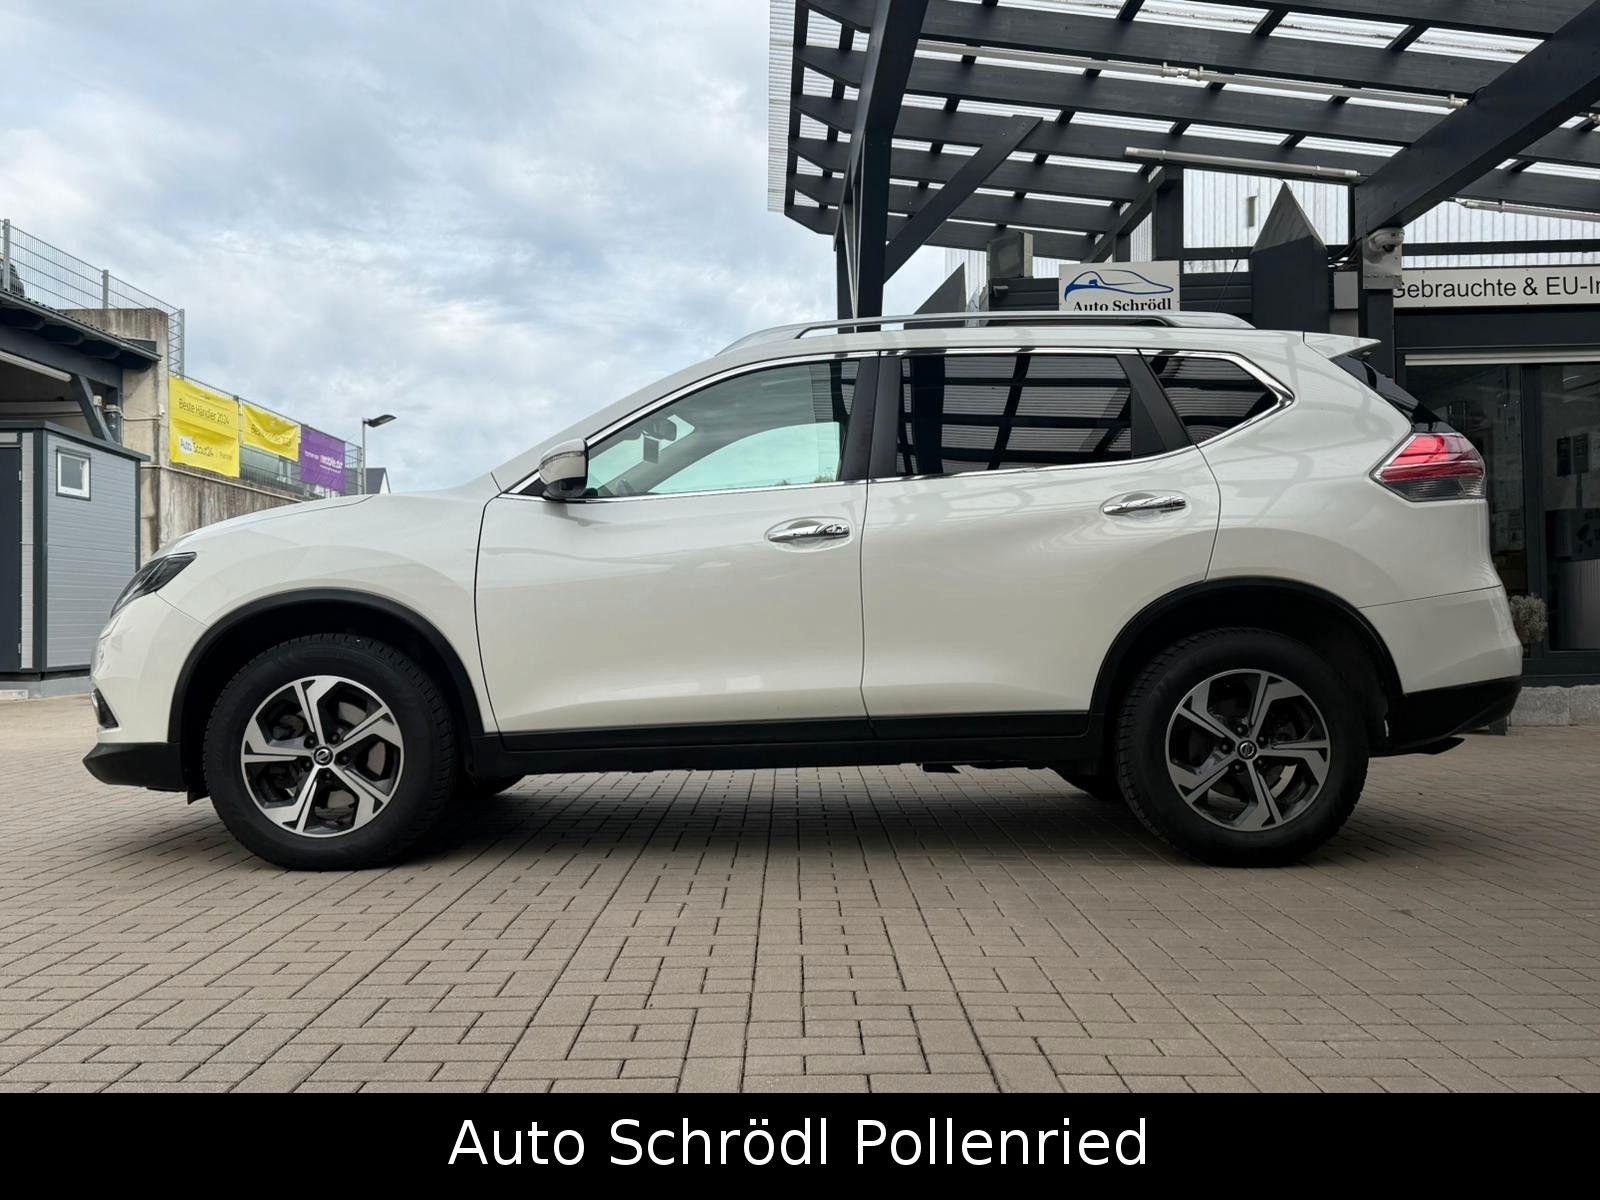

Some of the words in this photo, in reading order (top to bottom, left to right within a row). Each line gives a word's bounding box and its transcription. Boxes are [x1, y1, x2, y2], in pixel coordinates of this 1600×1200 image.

[1523, 277, 1538, 296] &
[1546, 275, 1600, 295] EU-I
[1073, 301, 1109, 311] Auto
[1112, 298, 1172, 311] Schrödl
[178, 398, 195, 414] Beste
